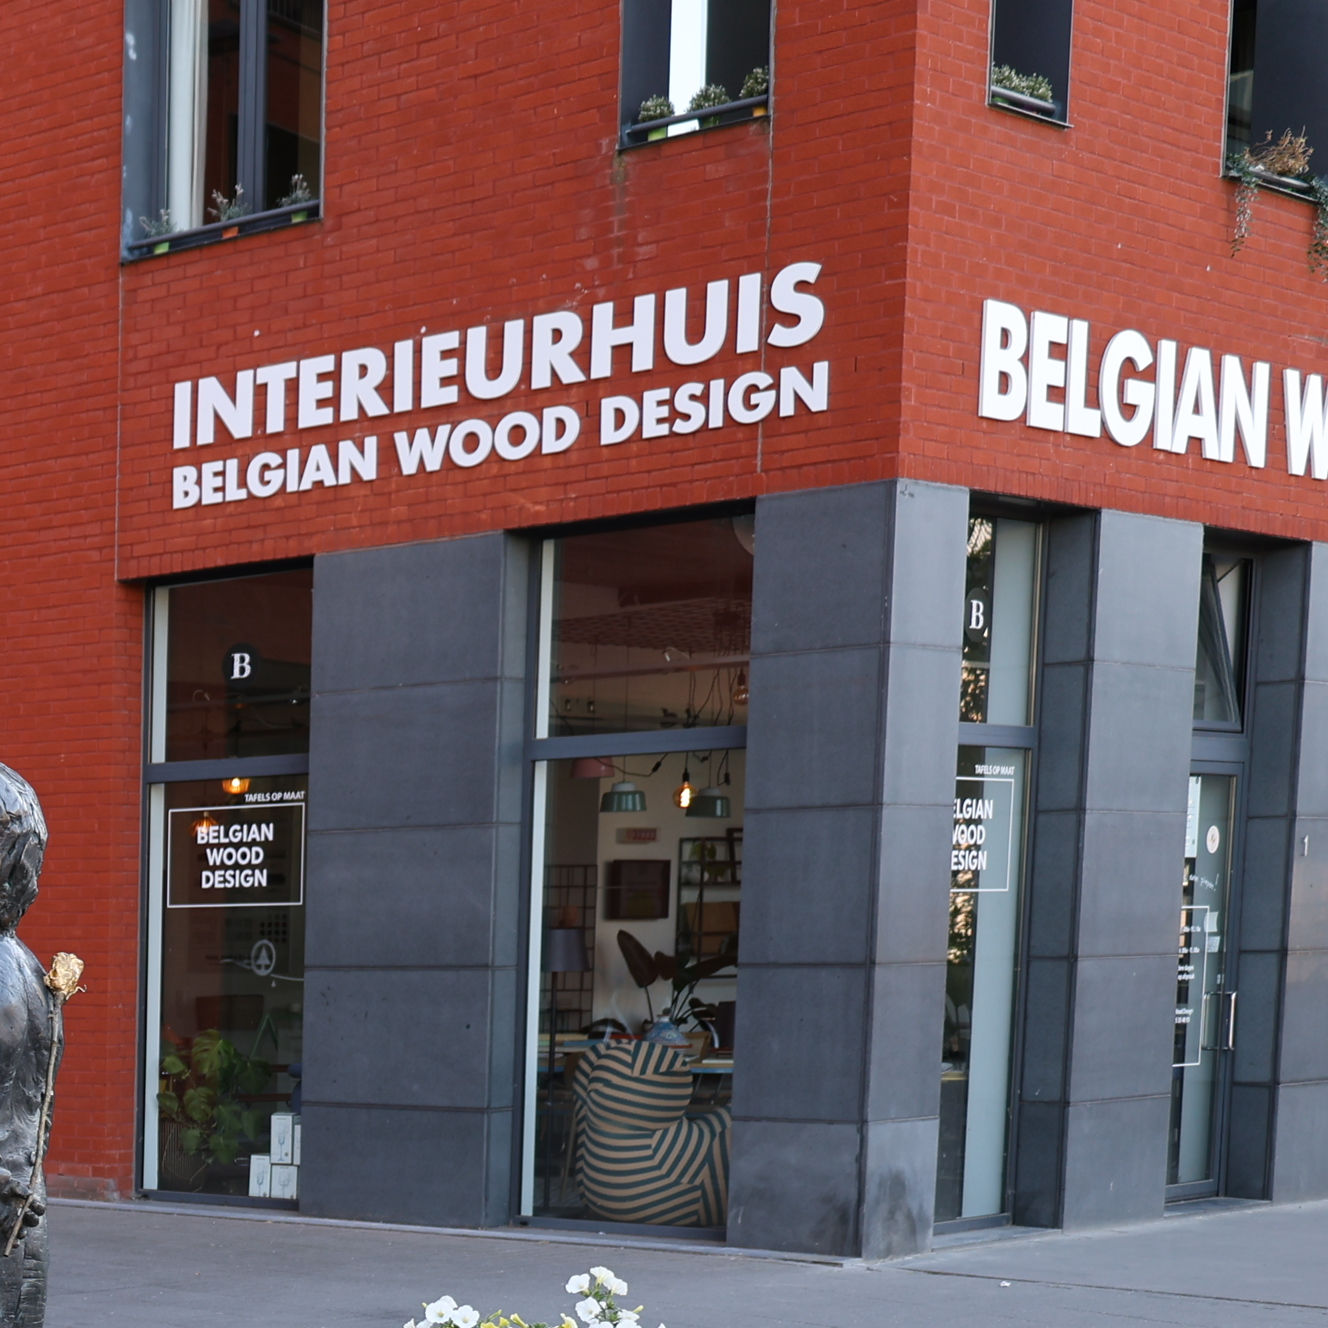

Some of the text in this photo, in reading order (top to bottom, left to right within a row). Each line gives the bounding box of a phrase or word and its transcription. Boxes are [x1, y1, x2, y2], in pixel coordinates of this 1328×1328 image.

[172, 261, 825, 450] INTERIEURHUIS
[977, 298, 1271, 468] BELGIAN
[172, 360, 830, 510] BELGIAN WOOD DESIGN
[969, 599, 984, 629] B
[230, 653, 251, 679] B
[975, 765, 992, 775] TAFELS
[1000, 766, 1015, 776] MAAT
[244, 790, 305, 803] TAFELS OP MAAT
[953, 798, 993, 820] LGIAN
[196, 822, 274, 845] BELGIAN
[206, 846, 264, 866] WOOD
[951, 850, 987, 871] ESIGN
[201, 869, 268, 889] DESIGN
